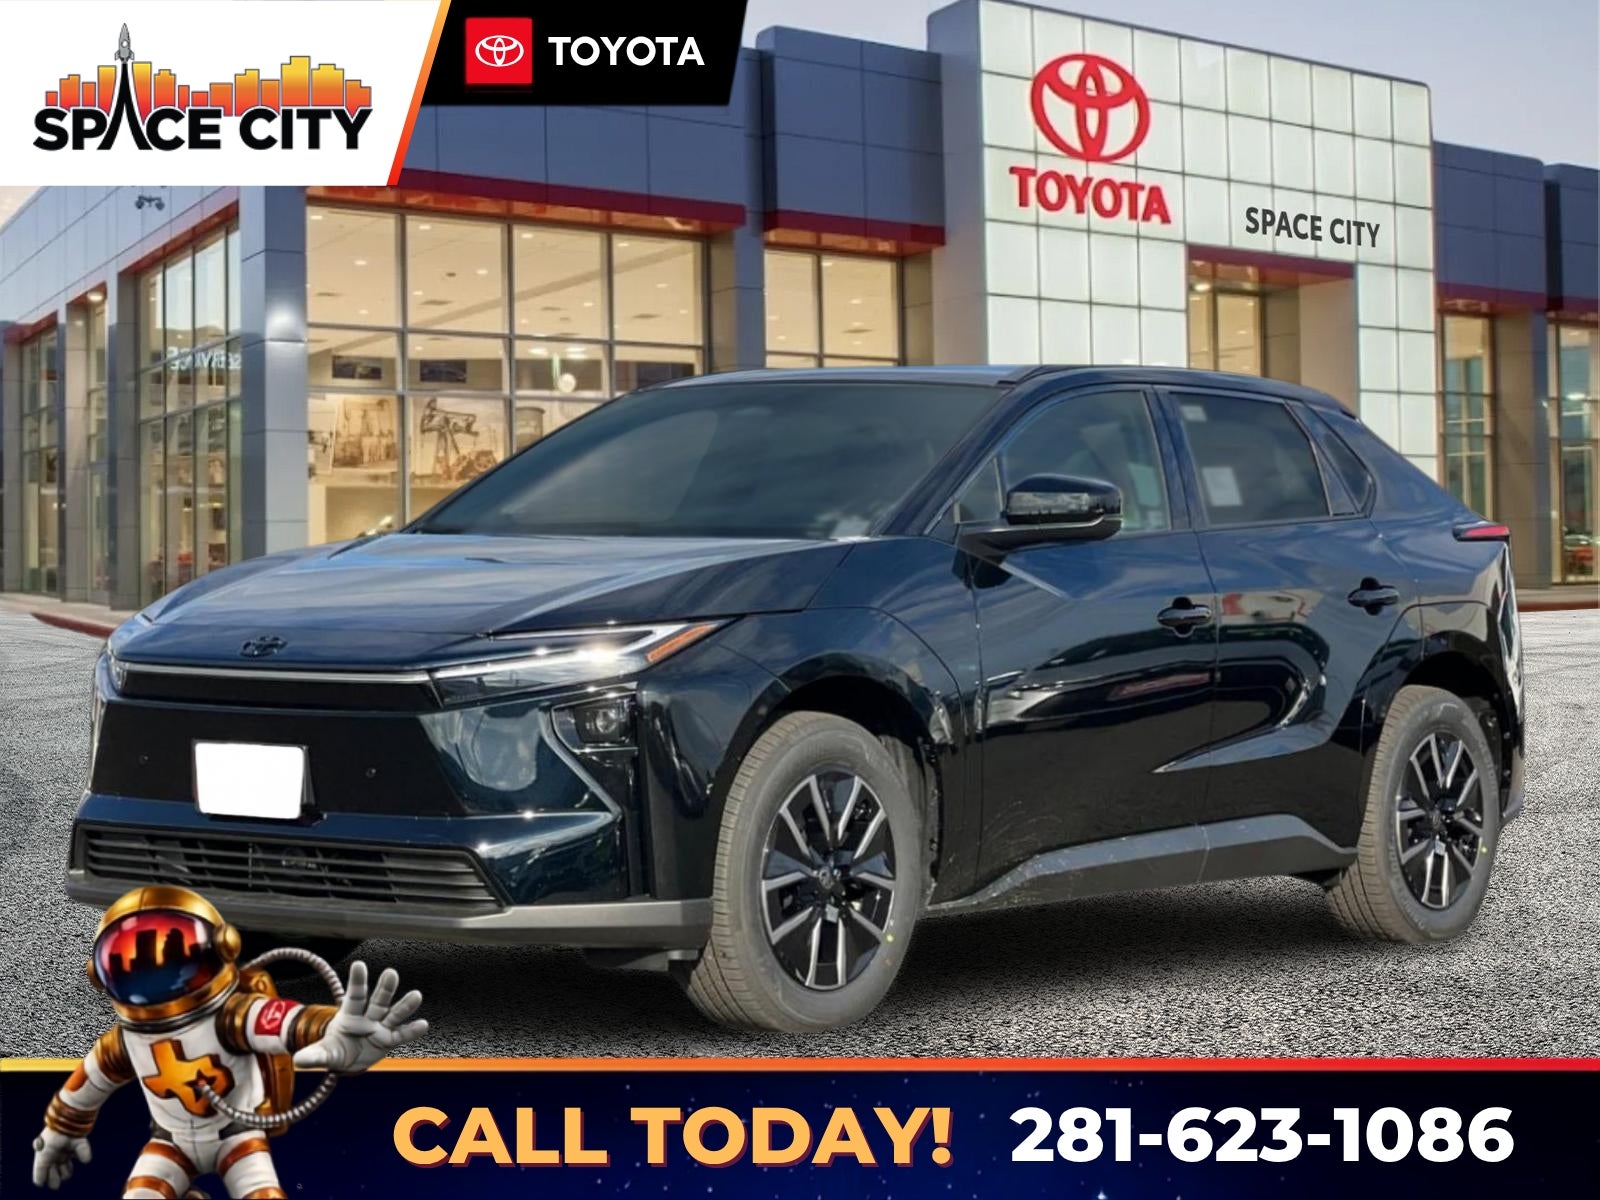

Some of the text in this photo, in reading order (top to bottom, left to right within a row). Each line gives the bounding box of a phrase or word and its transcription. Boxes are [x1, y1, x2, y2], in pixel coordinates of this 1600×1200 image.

[1009, 165, 1171, 224] TOYOTA
[1245, 206, 1381, 248] SPACE CITY
